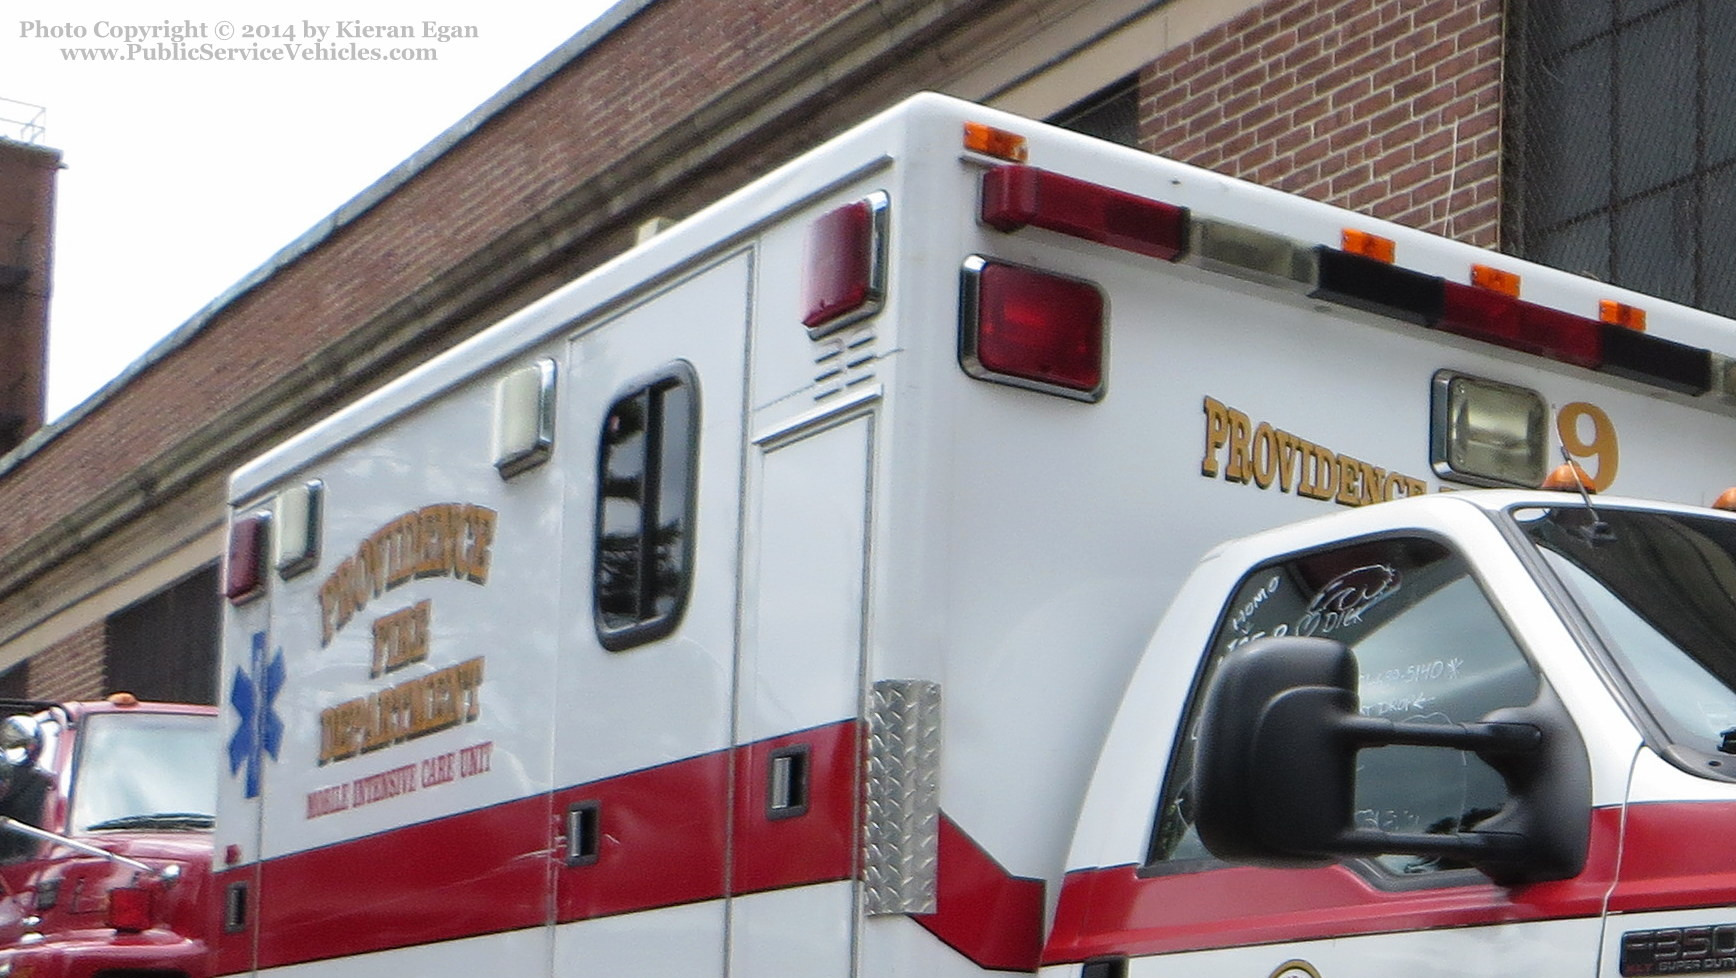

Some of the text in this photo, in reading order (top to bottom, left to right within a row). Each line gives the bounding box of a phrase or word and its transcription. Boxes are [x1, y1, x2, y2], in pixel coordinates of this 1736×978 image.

[1557, 401, 1620, 493] 9
[319, 503, 498, 648] PROVIDENCE
[370, 599, 432, 679] FIRE
[318, 657, 485, 767] DEPARTMENT
[307, 741, 492, 819] MOBILE INTENSIVE CARE UNIT
[1659, 960, 1701, 972] SUPER
